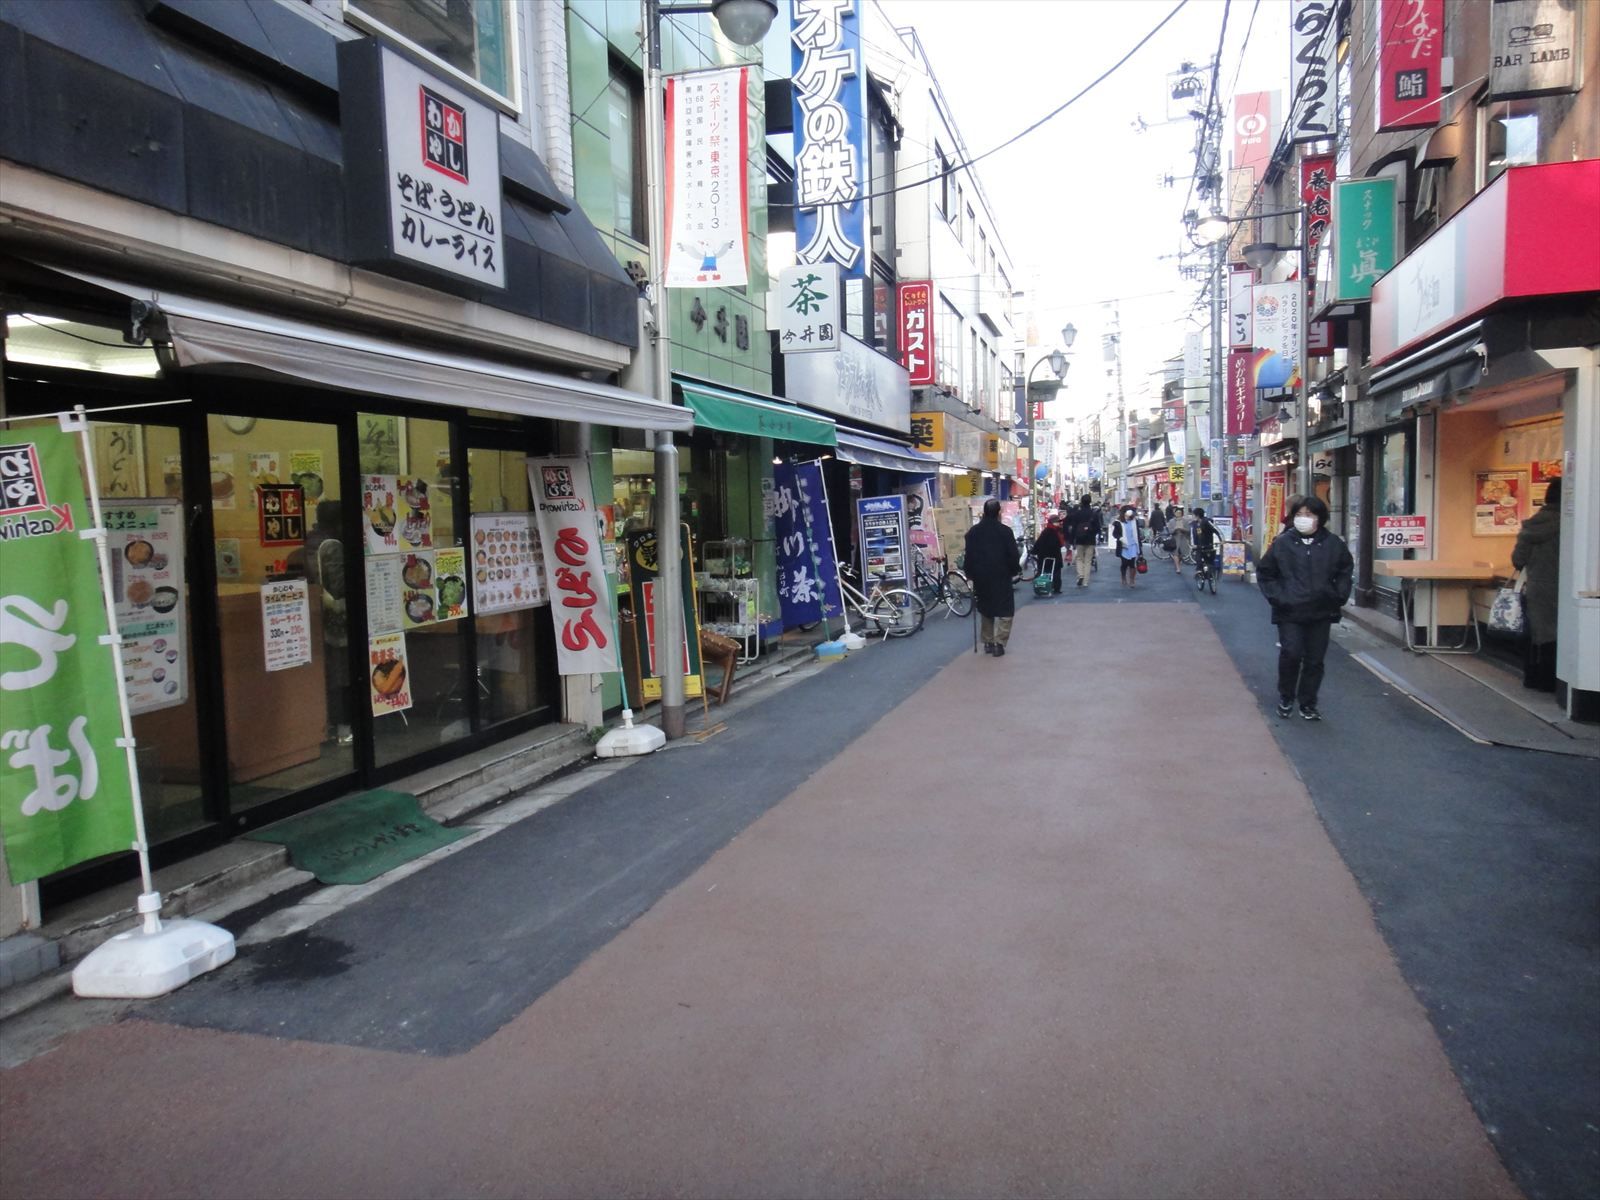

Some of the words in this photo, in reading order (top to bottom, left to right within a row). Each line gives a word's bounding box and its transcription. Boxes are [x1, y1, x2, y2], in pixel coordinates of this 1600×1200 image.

[1494, 54, 1523, 68] BAR
[1529, 48, 1570, 64] LAMB
[1398, 73, 1423, 98] 鮨
[709, 82, 721, 229] スポーツ祭東京2013
[401, 212, 496, 272] カレーライス
[788, 273, 829, 316] 茶
[904, 290, 926, 299] Café
[906, 309, 925, 373] ガスト
[911, 418, 933, 447] 薬
